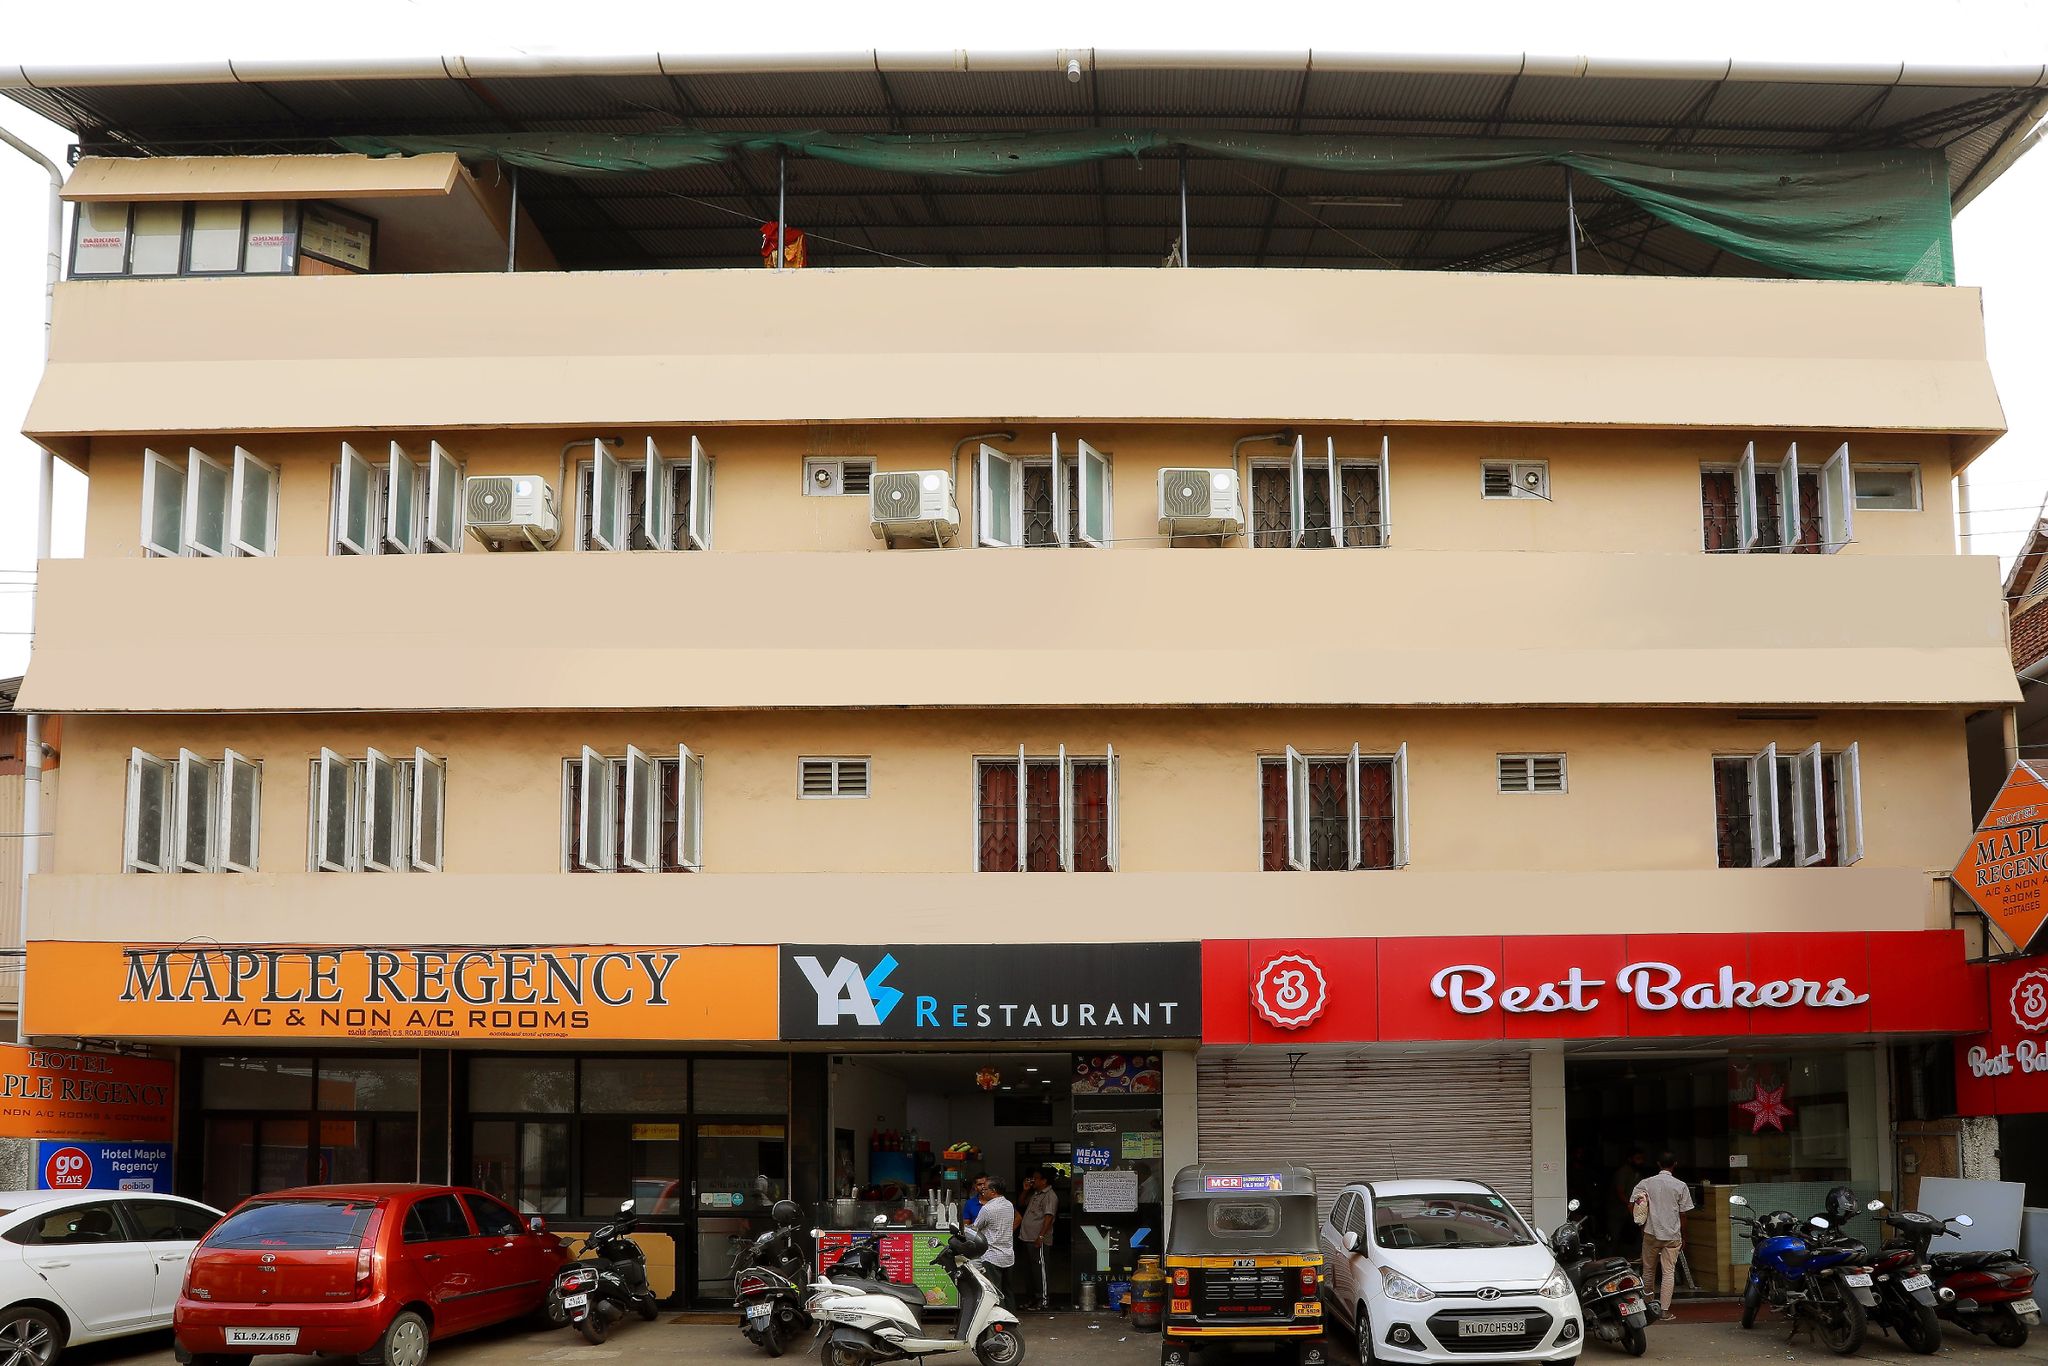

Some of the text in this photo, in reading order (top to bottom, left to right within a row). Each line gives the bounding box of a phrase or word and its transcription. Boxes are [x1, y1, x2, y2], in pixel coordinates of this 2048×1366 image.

[1996, 805, 2039, 826] HOTEL
[2015, 878, 2038, 891] NON
[2002, 889, 2040, 904] ROOMS
[2003, 901, 2040, 916] COTTAGES
[118, 949, 680, 1006] MAPLE REGENCY
[1430, 961, 1870, 1013] Best Bakers
[221, 1008, 589, 1028] A/C & NON A/C ROOMS
[424, 1029, 460, 1037] ERNAKULAM
[28, 1050, 113, 1074] HOTEL
[1968, 1045, 2015, 1077] Best
[60, 1077, 168, 1106] REGENCY
[59, 1111, 100, 1120] ROOMS
[101, 1149, 167, 1161] Hotel Maple
[1076, 1149, 1110, 1158] MEALS
[55, 1155, 83, 1175] go
[112, 1161, 159, 1173] Regency
[56, 1175, 82, 1184] STAYS
[122, 1182, 150, 1190] goibibo
[1211, 1178, 1239, 1187] MCR
[1173, 1300, 1189, 1311] STOP
[1465, 1321, 1524, 1333] KL07CH5992
